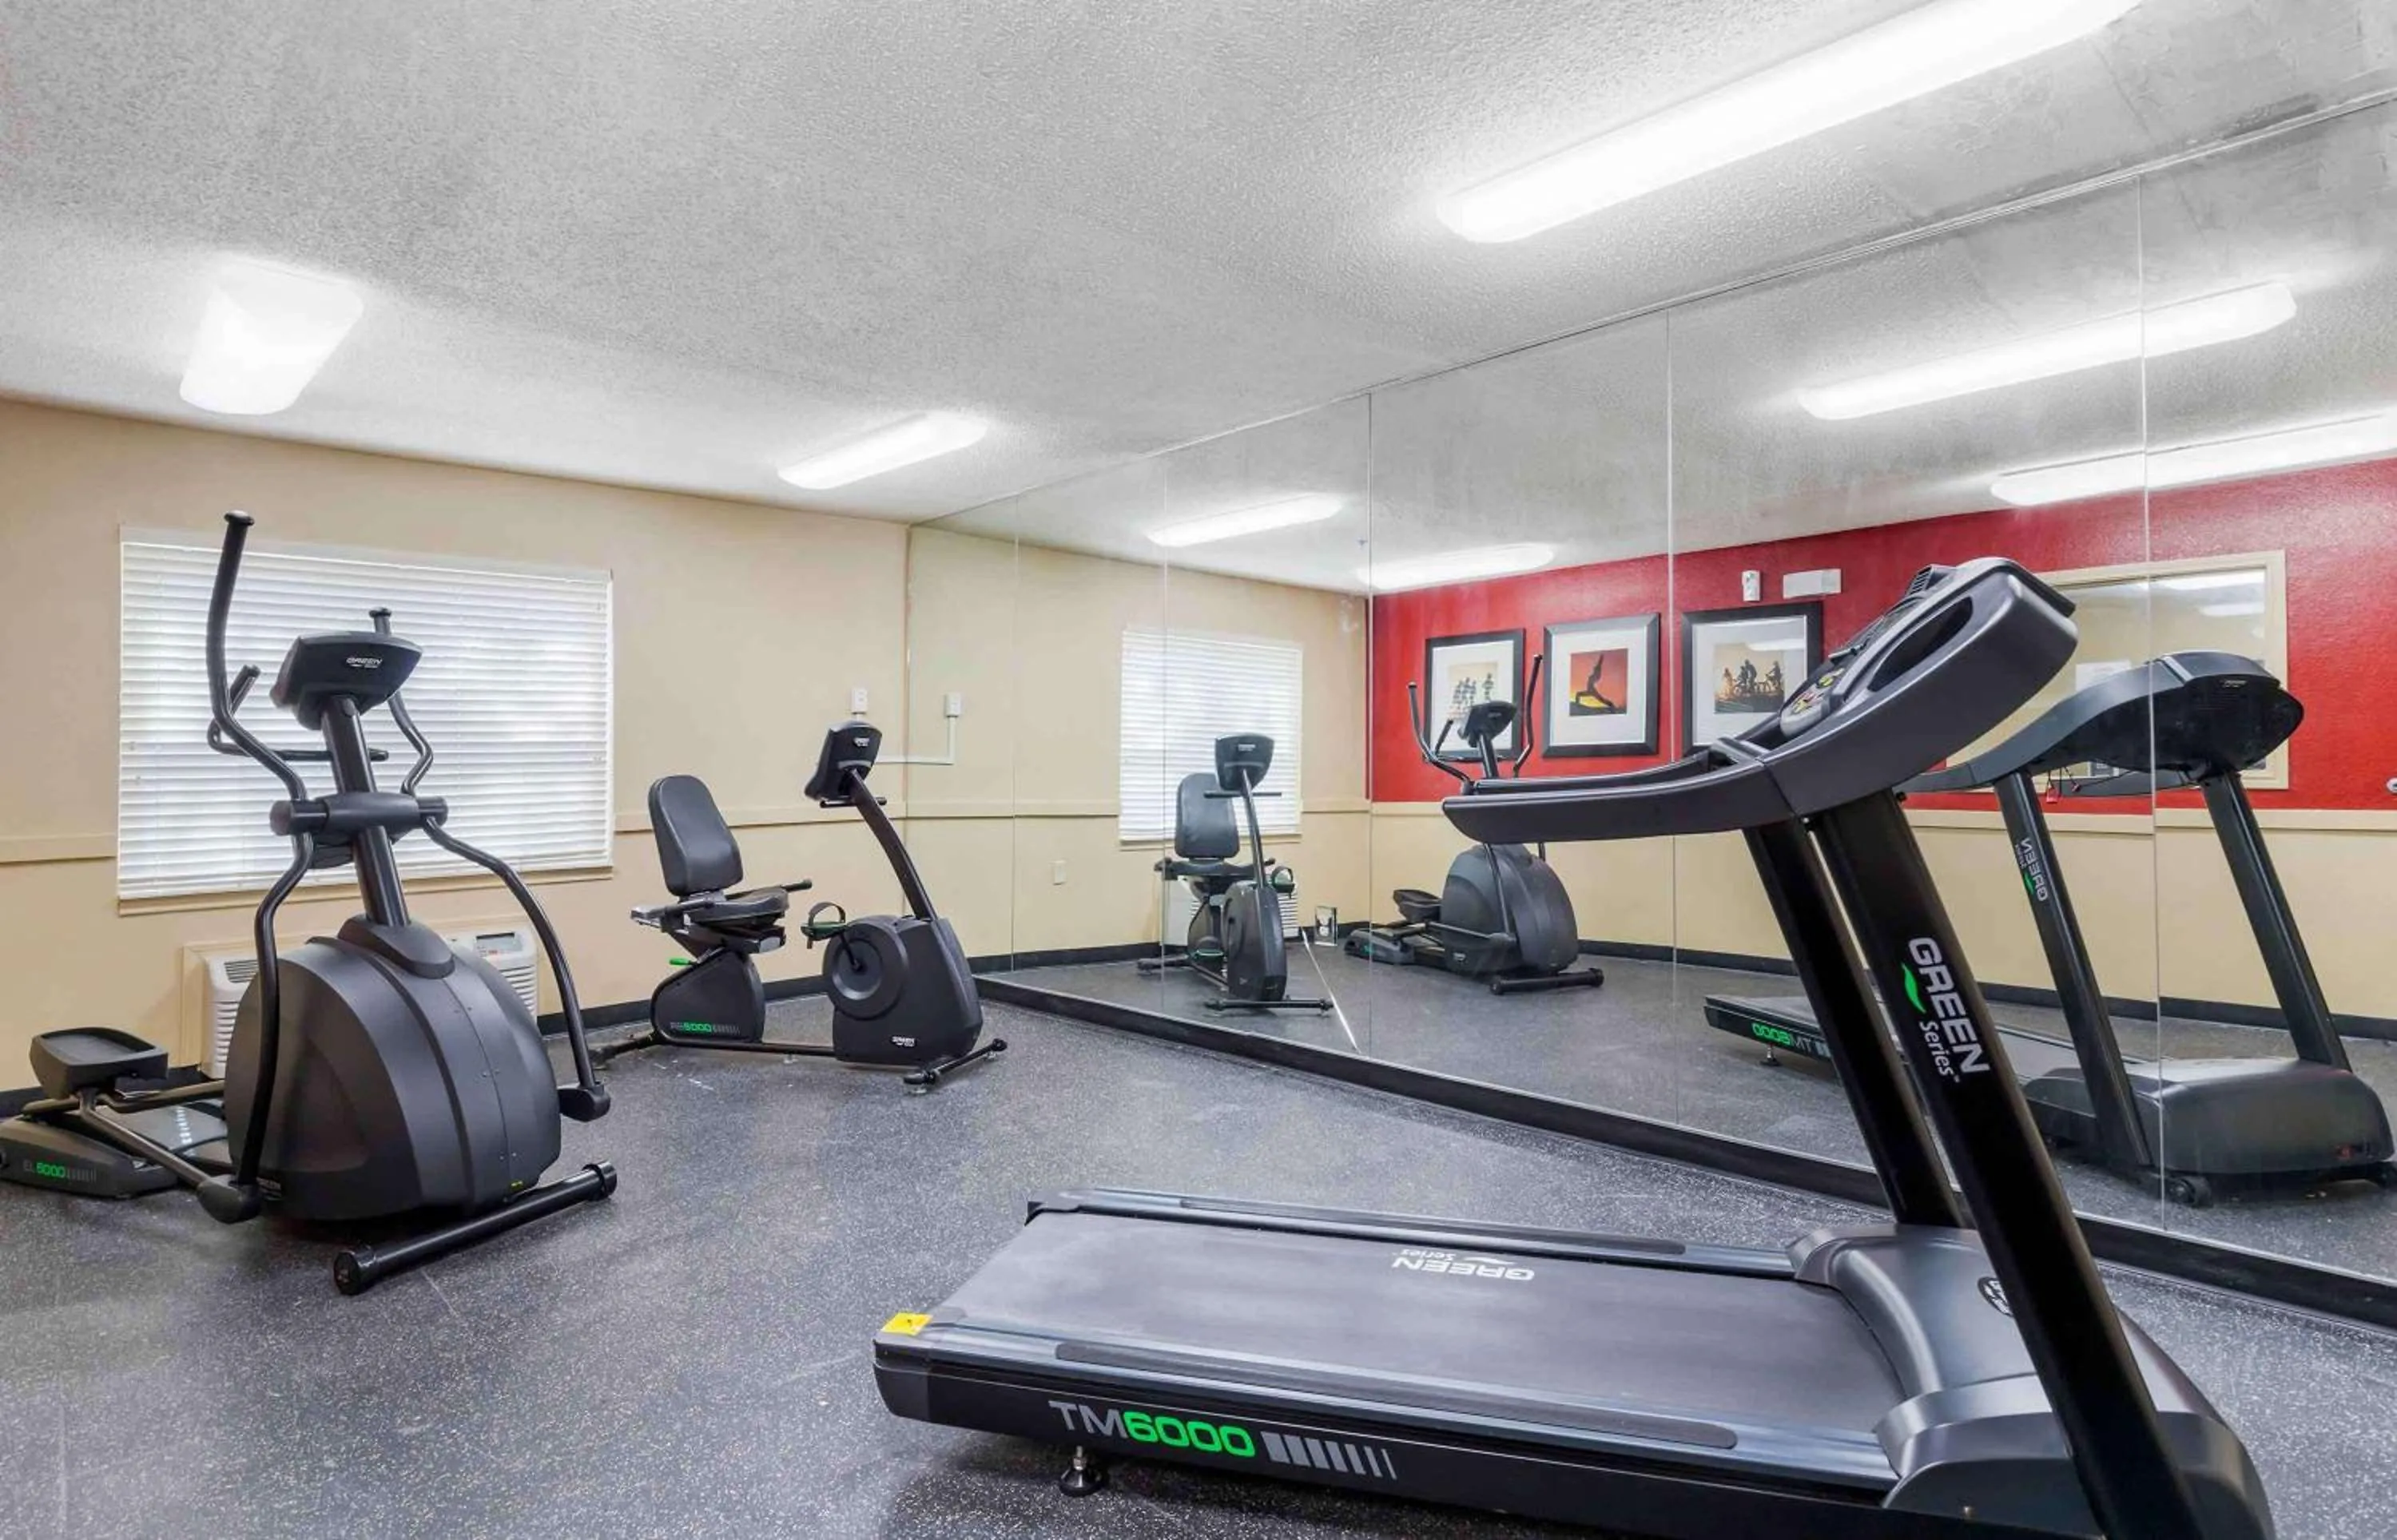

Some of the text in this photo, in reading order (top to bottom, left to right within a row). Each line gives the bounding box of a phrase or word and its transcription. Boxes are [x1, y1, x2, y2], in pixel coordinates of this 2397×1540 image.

[1908, 937, 1990, 1073] GREEN
[1391, 1256, 1536, 1281] GREEN
[1047, 1400, 1255, 1457] TM6000
